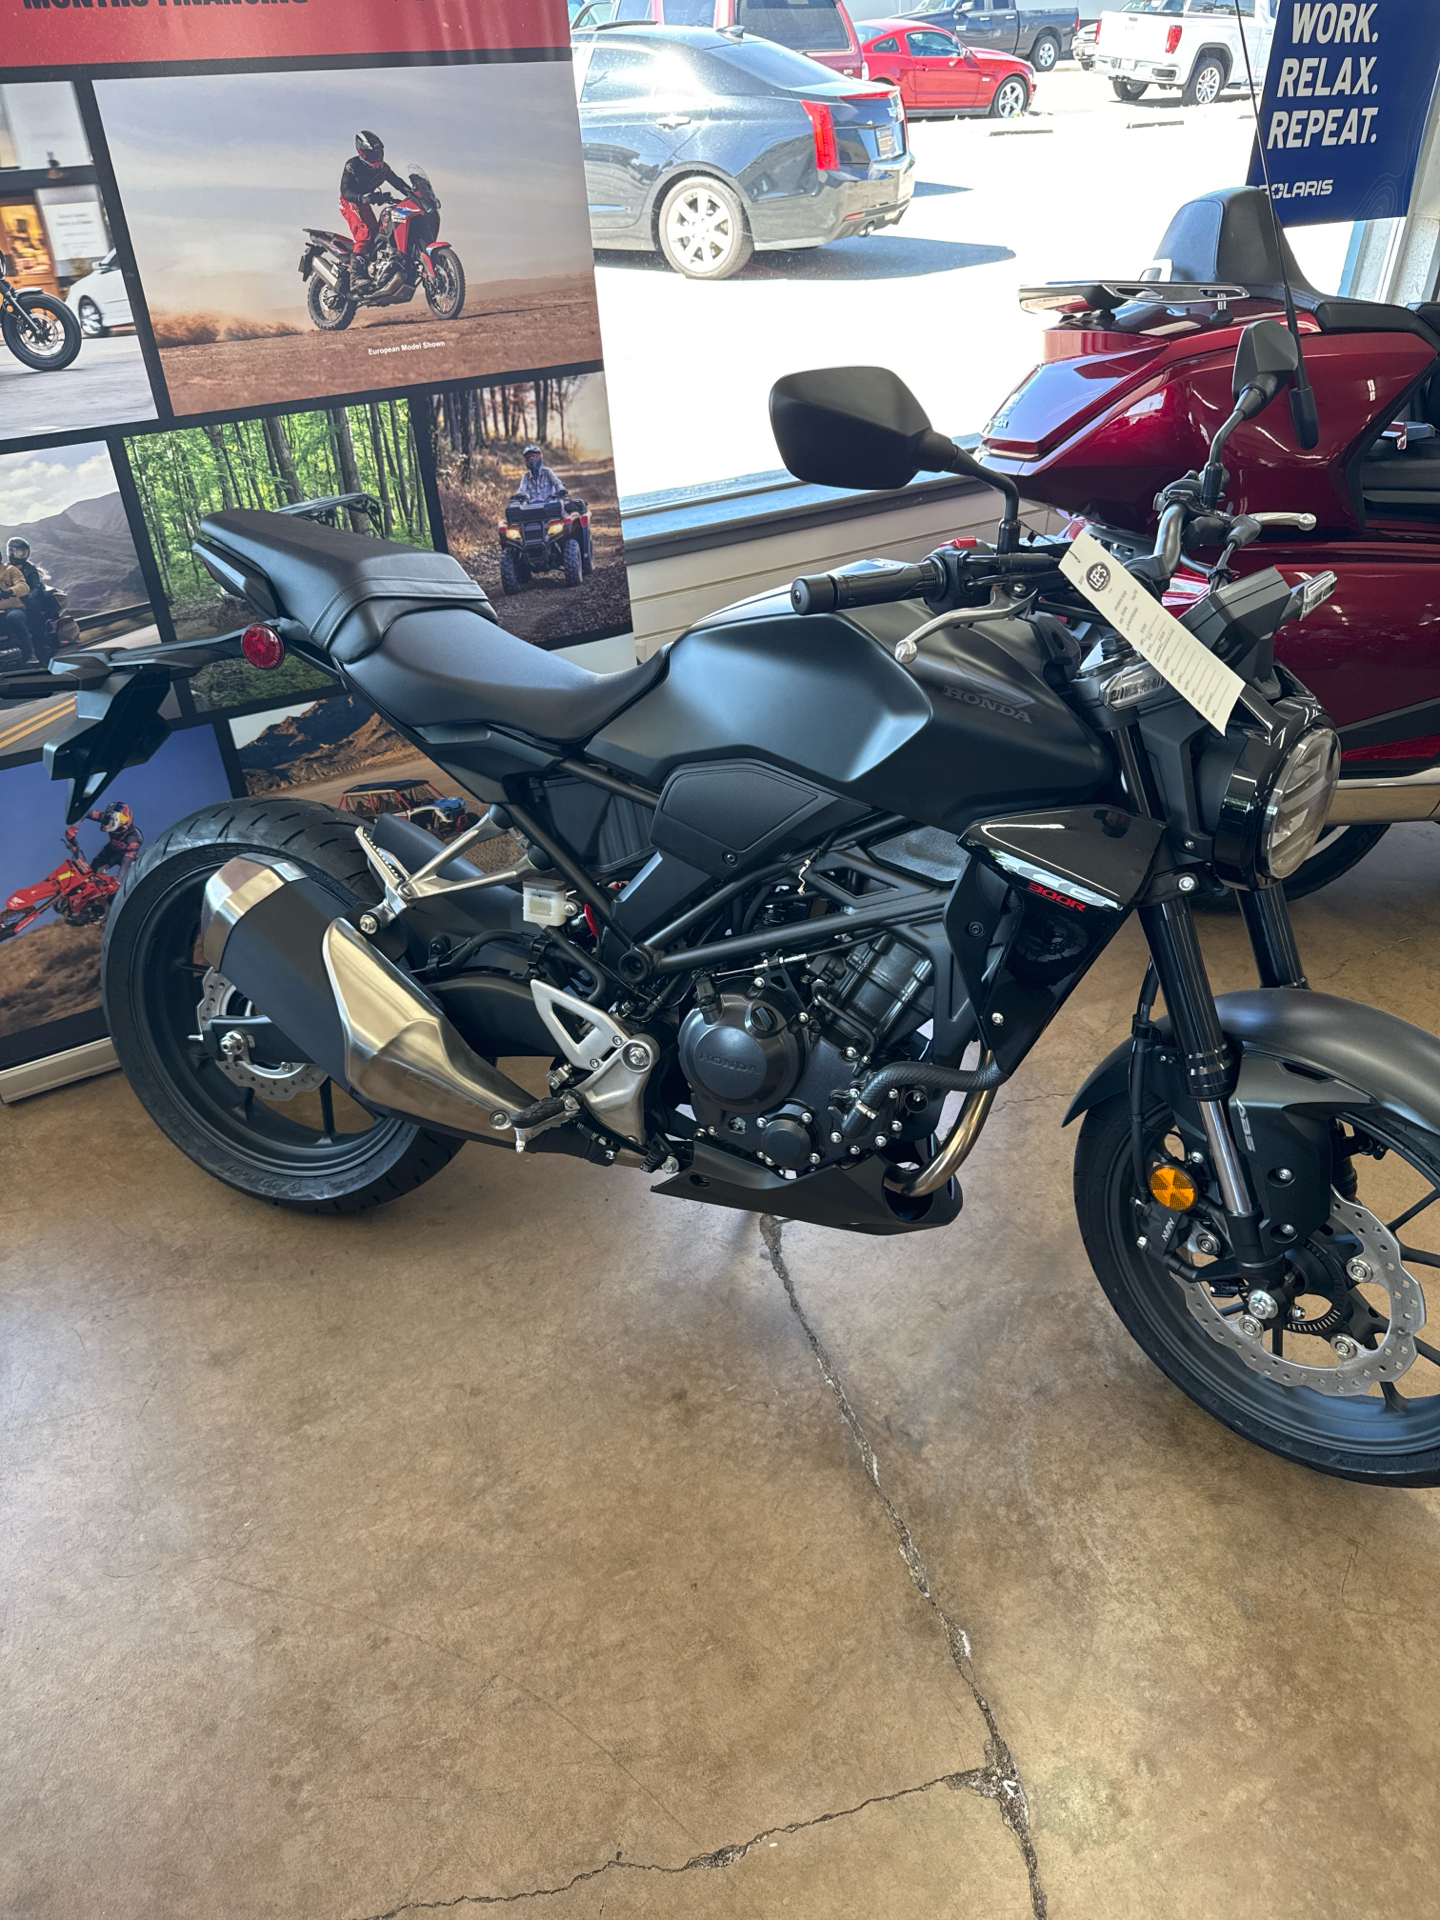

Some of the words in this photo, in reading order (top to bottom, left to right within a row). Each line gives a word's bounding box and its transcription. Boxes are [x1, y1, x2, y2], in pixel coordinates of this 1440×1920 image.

[1292, 3, 1379, 44] WORK.
[1277, 56, 1378, 97] RELAX.
[1267, 107, 1379, 149] REPEAT.
[401, 343, 421, 351] Model
[422, 341, 446, 349] Shown
[1088, 565, 1108, 590] LEE'S
[943, 685, 1033, 724] HONDA
[1027, 881, 1086, 912] 300R
[699, 1052, 762, 1076] HONDA
[1234, 1098, 1255, 1153] ABS
